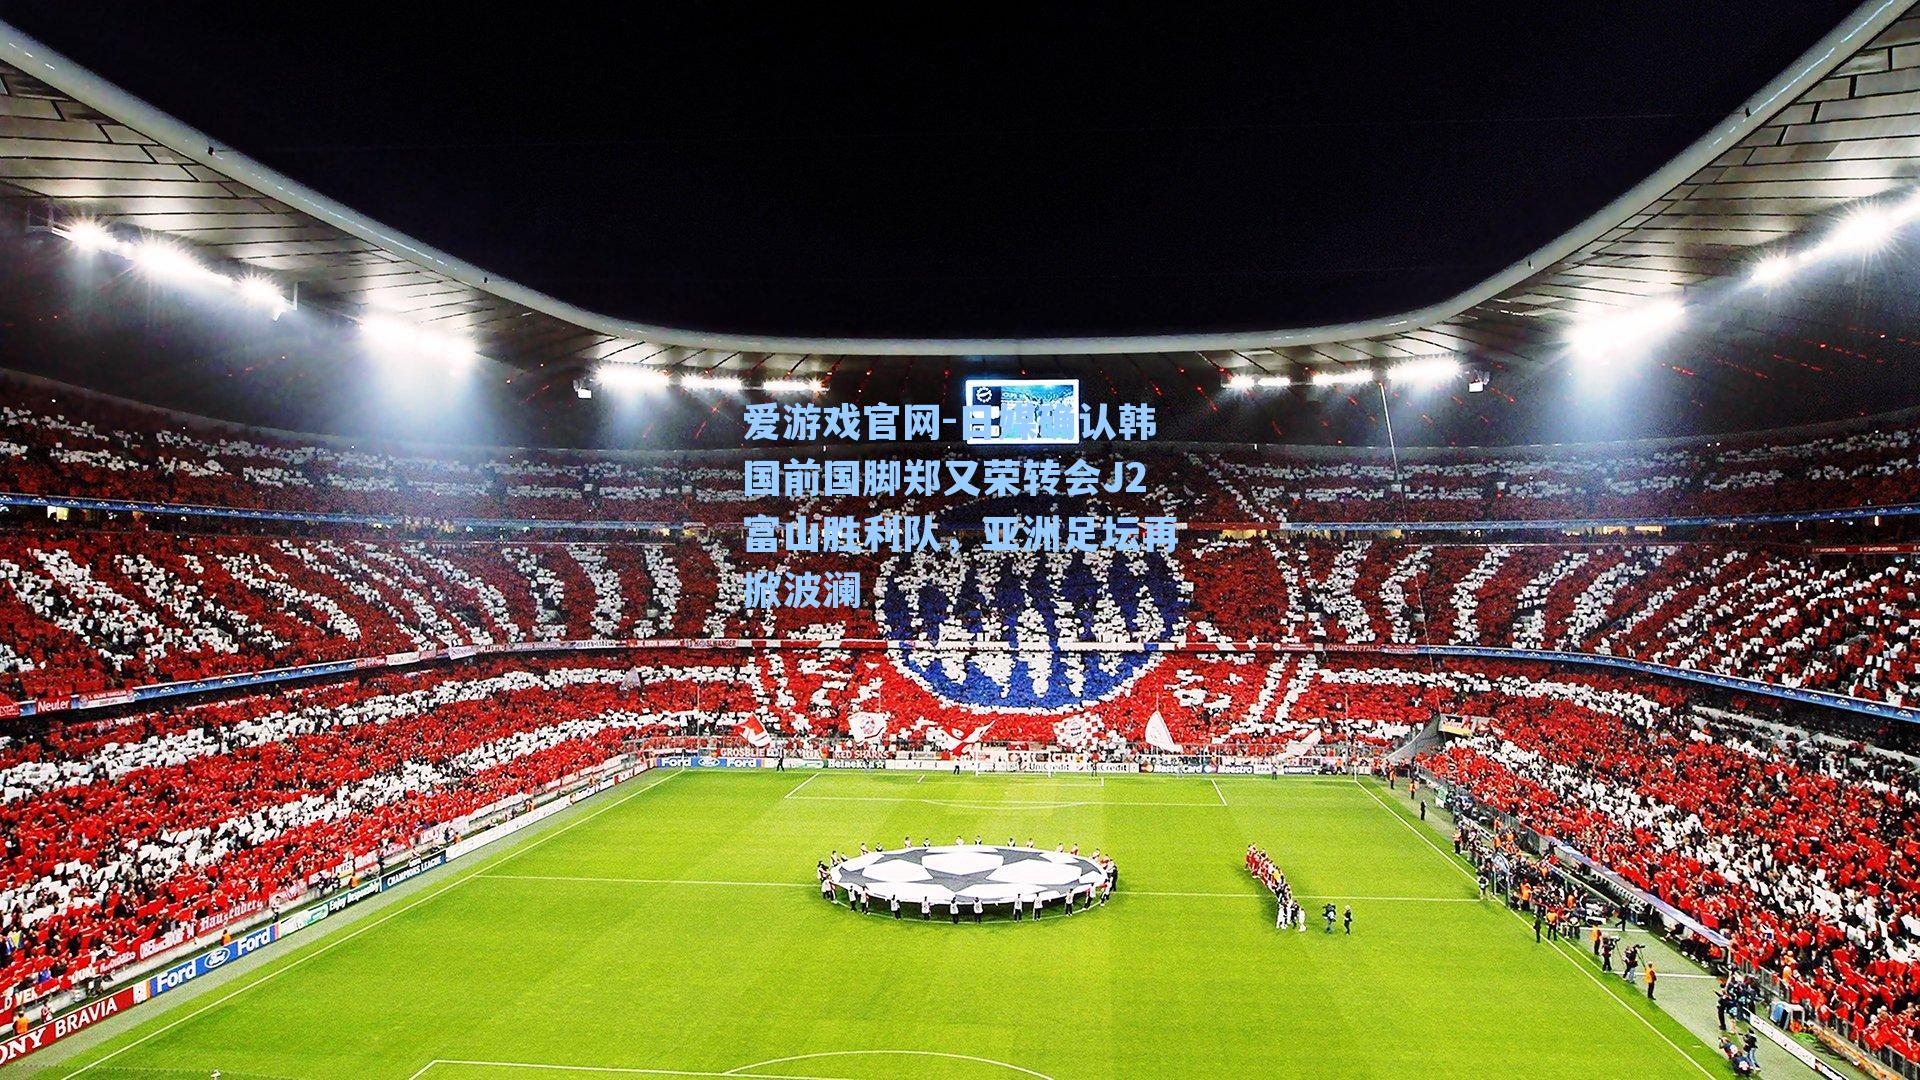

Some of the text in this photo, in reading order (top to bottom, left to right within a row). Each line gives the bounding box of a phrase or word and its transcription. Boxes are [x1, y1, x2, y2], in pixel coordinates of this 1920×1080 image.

[38, 700, 70, 712] Neuler
[661, 757, 691, 767] Ford
[727, 758, 756, 768] Ford
[238, 926, 270, 956] Ford
[157, 960, 197, 993] Ford
[0, 997, 118, 1065] ONY BRAVIA
